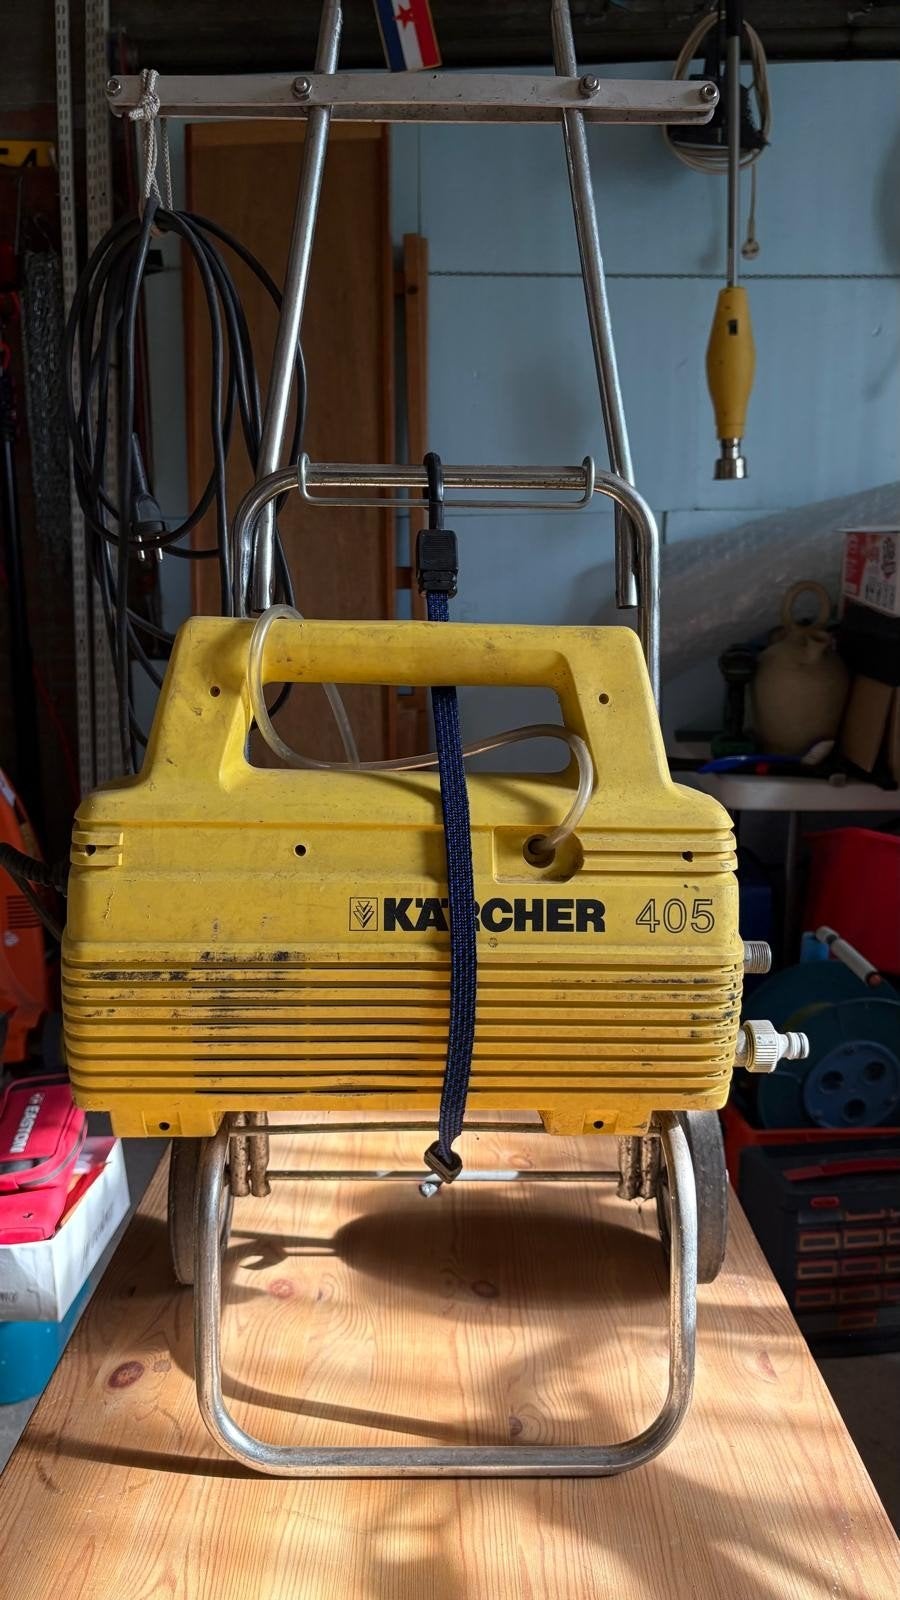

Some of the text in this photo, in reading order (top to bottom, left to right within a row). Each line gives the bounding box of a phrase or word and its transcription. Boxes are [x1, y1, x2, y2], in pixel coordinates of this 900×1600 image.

[384, 898, 715, 933] KÄCHER 405
[10, 1105, 40, 1153] EASTON
